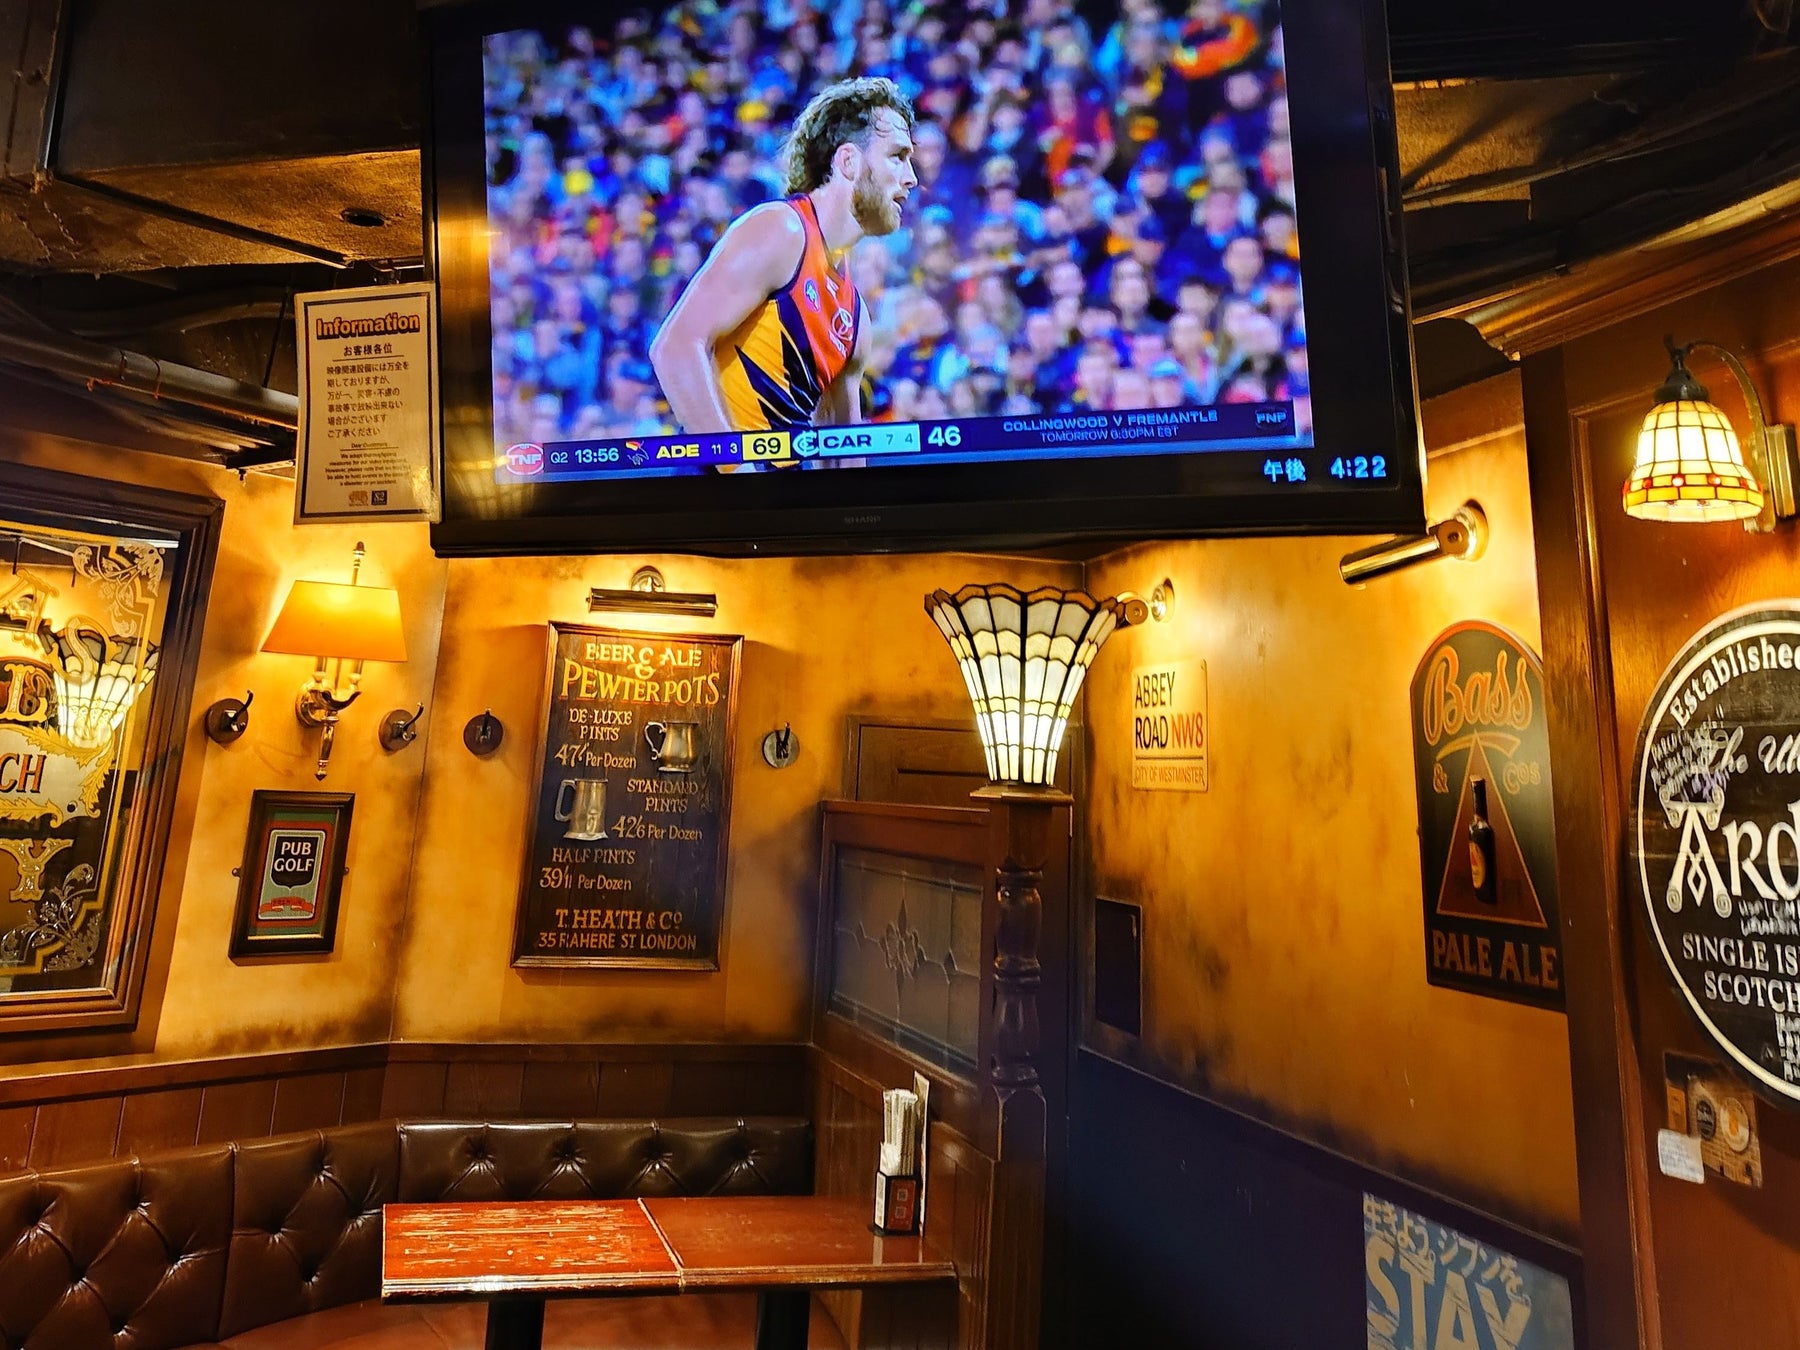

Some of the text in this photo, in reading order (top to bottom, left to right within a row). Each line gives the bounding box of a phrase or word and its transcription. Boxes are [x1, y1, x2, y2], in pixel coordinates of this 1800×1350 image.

[316, 312, 420, 340] Information
[343, 343, 393, 356] お客様各位
[1003, 409, 1218, 432] COLLINGWOOD V FREMANTLE
[550, 425, 961, 464] Q2 13:56 ADE 11 3 69 CAR 7 4 46
[1041, 429, 1108, 443] TOMORROW
[1264, 455, 1386, 482] 午後 4:22
[586, 643, 635, 663] BEER
[659, 647, 702, 667] ALE
[560, 657, 720, 705] PEWTER POTS
[1135, 671, 1175, 709] ABBEY
[1423, 645, 1532, 746] Bass
[569, 708, 633, 725] DE-LUXE
[580, 725, 620, 741] PINTS
[1135, 712, 1204, 750] ROAD NW8
[585, 751, 603, 767] Per
[604, 752, 636, 769] Dozen
[626, 778, 699, 795] STANDARD
[1433, 763, 1449, 793] &
[645, 797, 688, 813] PINTS
[648, 825, 666, 839] Per
[668, 825, 702, 840] Dozen
[281, 842, 312, 855] PUB
[552, 847, 636, 865] HALF PINTS
[273, 858, 315, 872] GOLF
[577, 873, 596, 889] Per
[597, 874, 632, 891] Dozen
[571, 908, 642, 929] HEATH
[646, 911, 656, 930] &
[538, 932, 556, 948] 35
[640, 934, 697, 950] LONDON
[1682, 931, 1770, 971] SINGLE
[1432, 929, 1558, 989] PALE ALE
